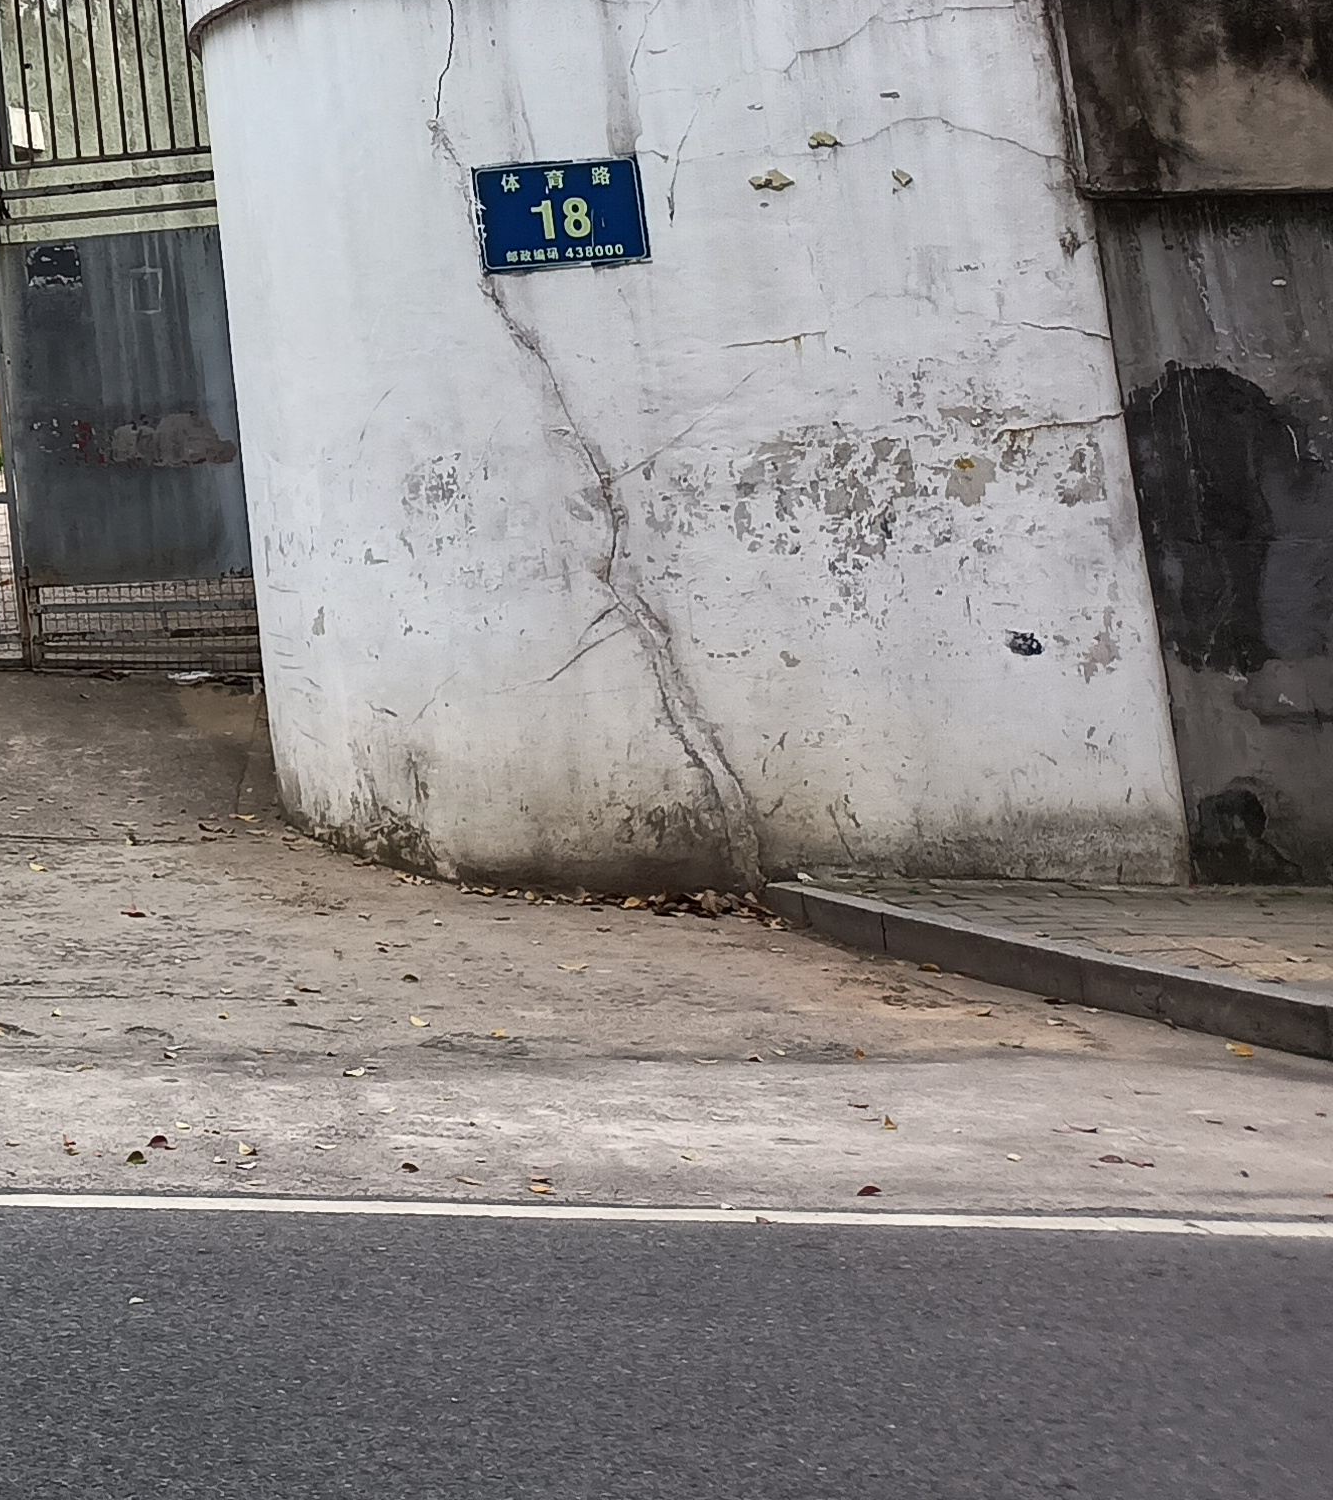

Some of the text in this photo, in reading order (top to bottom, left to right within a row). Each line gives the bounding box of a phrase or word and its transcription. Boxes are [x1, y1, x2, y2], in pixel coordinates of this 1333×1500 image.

[500, 165, 611, 193] 体育路
[530, 196, 592, 240] 18
[506, 243, 624, 263] 邮政编码 438000
